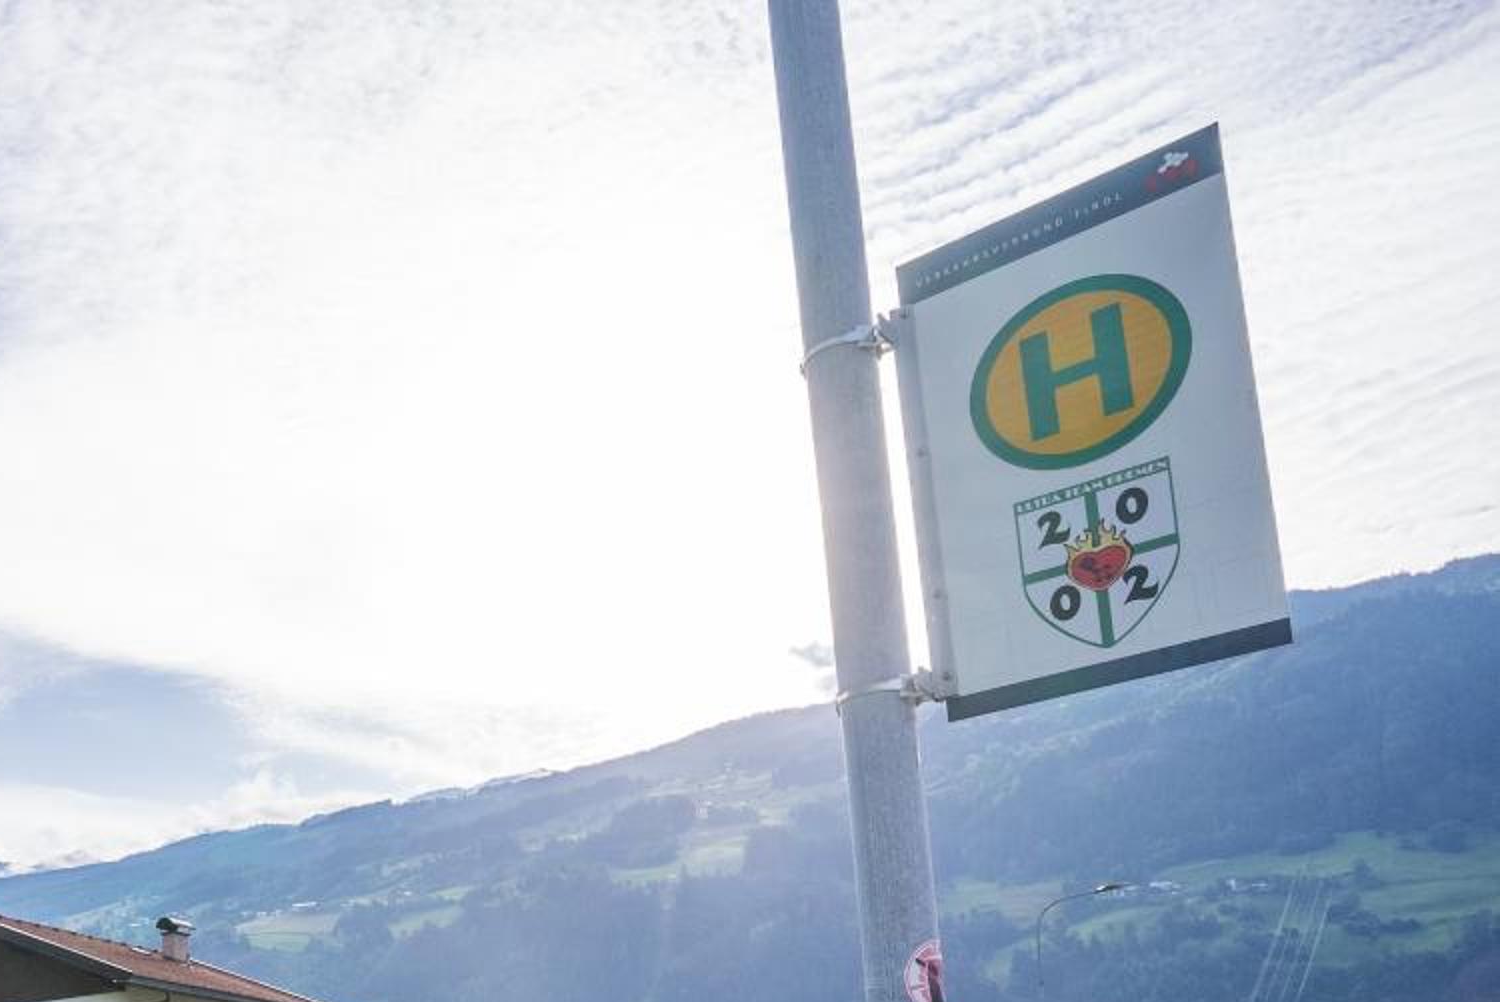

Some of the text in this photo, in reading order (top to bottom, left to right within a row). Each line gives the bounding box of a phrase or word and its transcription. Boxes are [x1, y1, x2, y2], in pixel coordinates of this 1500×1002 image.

[1019, 303, 1134, 441] H
[1037, 487, 1149, 549] 2 0
[1050, 564, 1159, 621] 0 2
